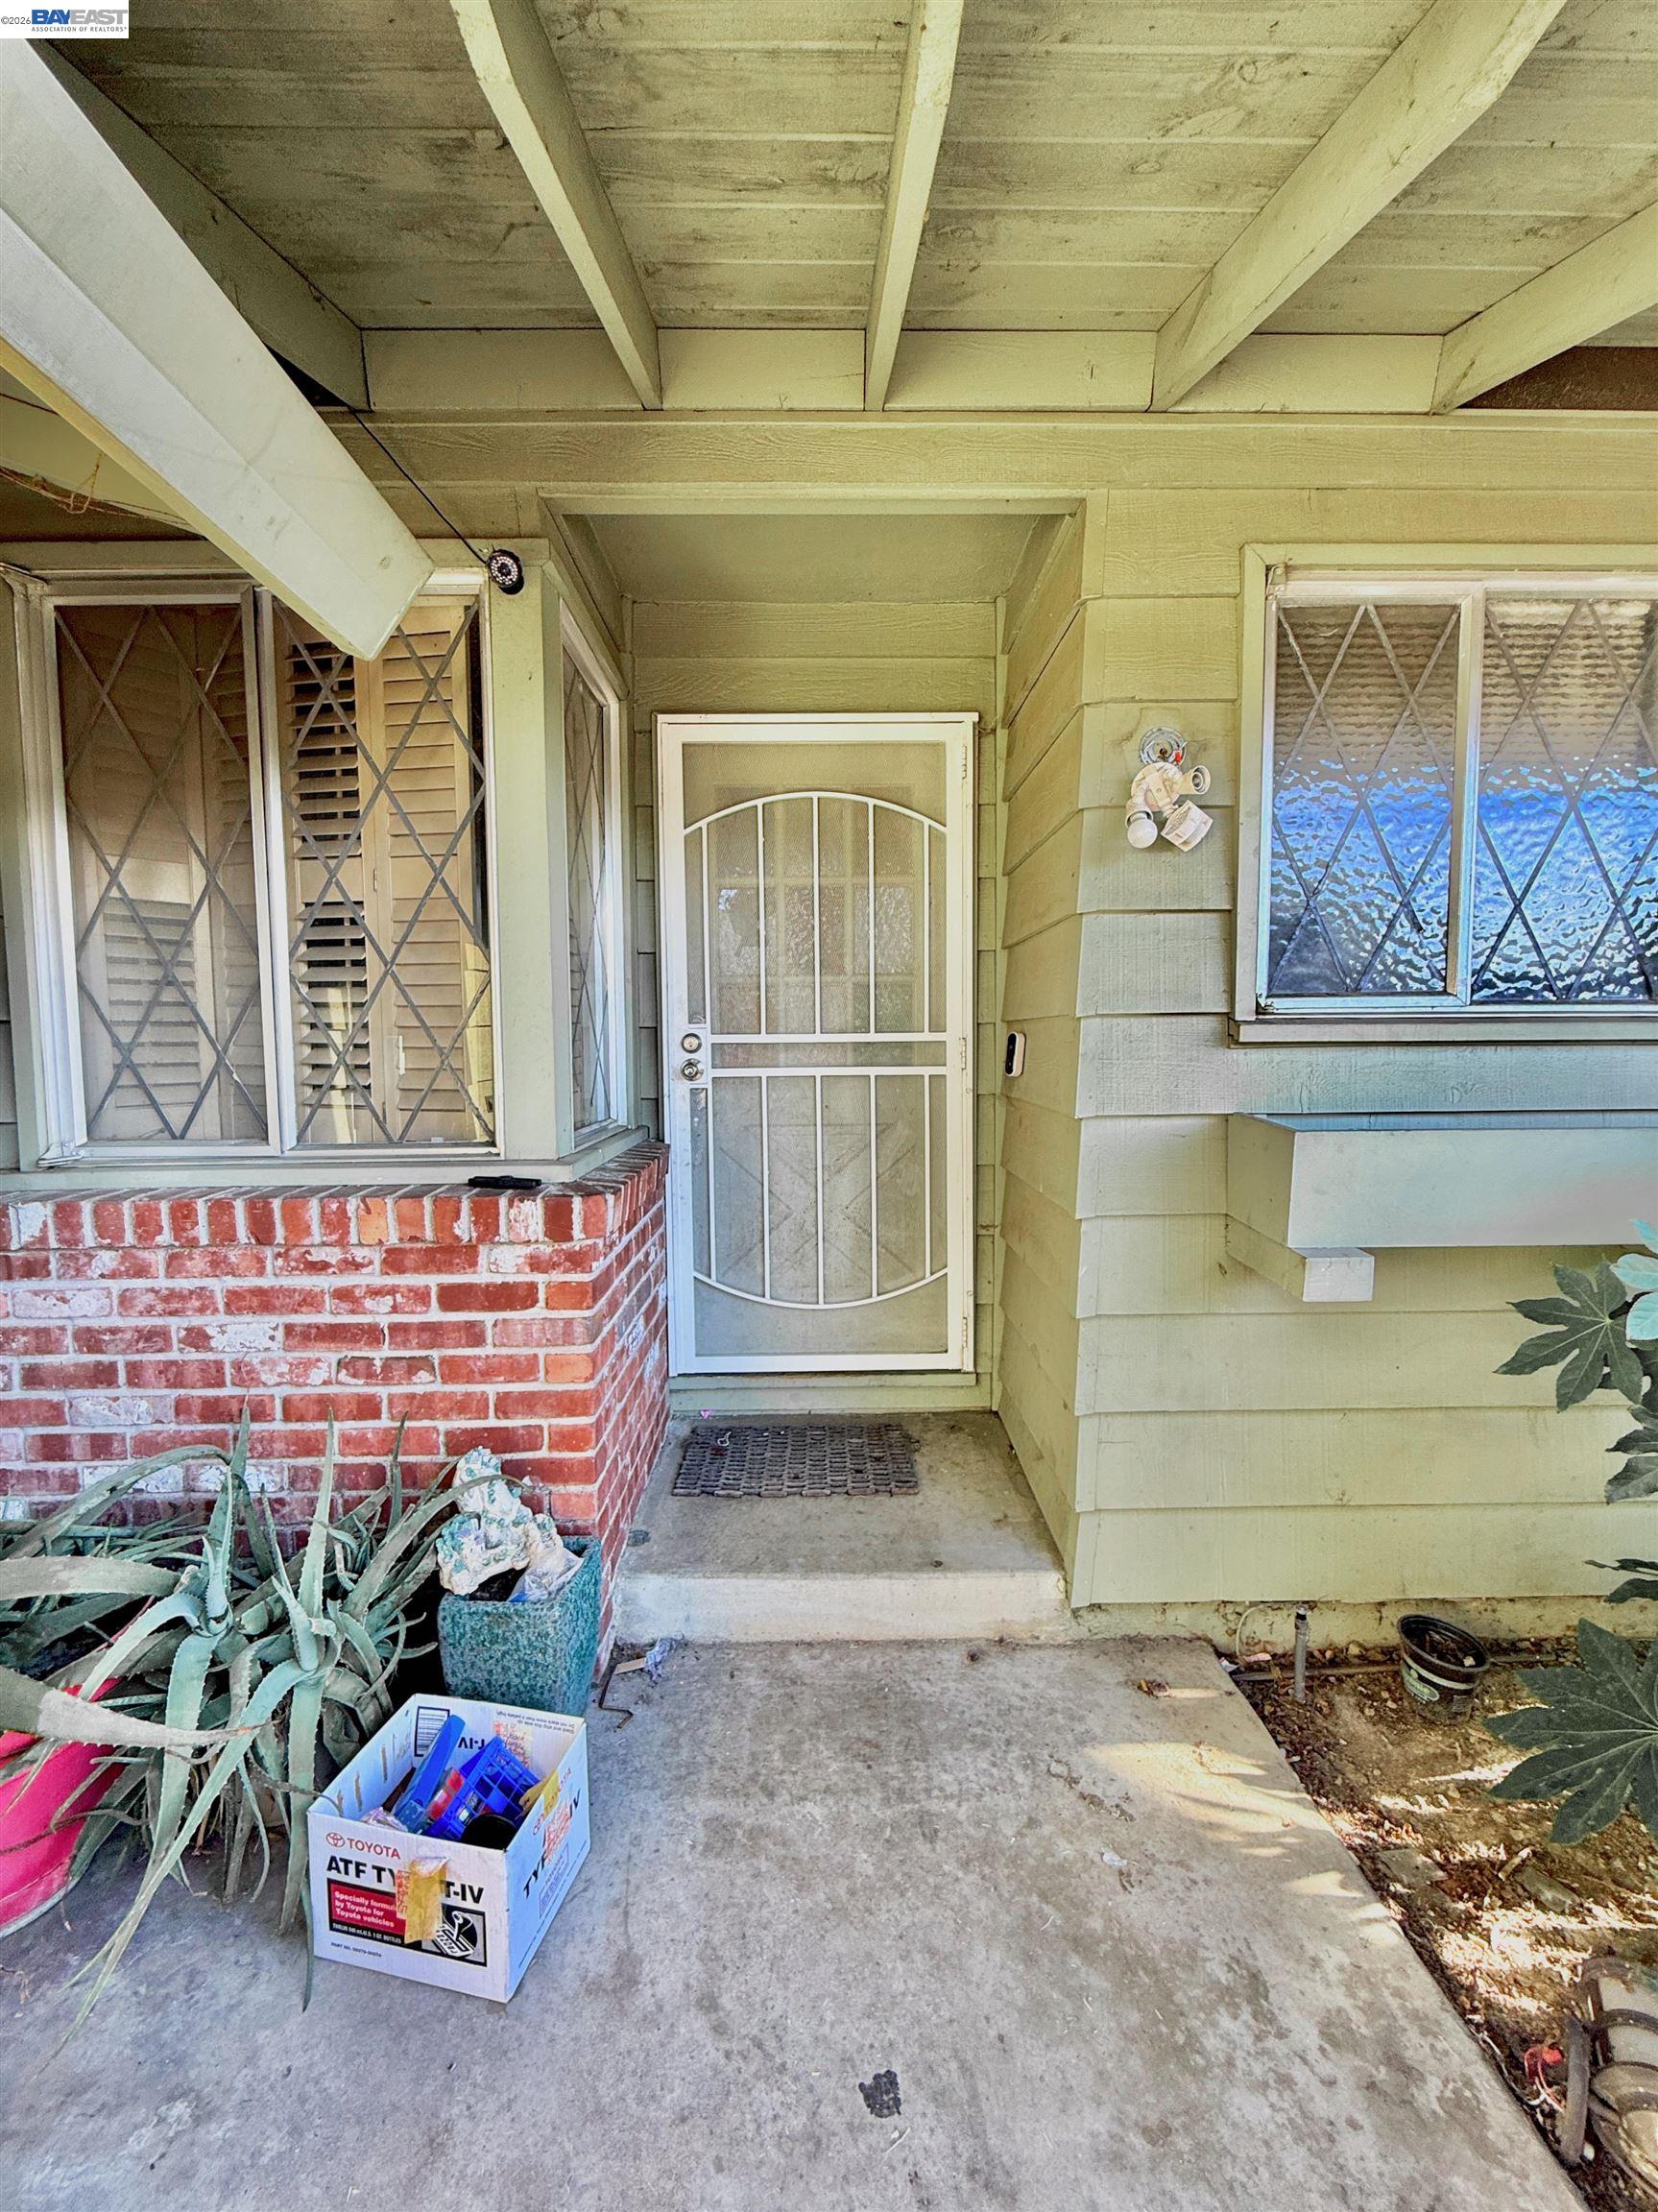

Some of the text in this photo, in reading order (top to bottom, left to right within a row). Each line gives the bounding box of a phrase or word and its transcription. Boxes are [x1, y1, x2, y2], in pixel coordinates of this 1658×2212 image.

[347, 1838, 401, 1860] TOYOTA
[327, 1855, 484, 1904] ATF TY T-IV
[334, 1891, 396, 1911] Specially formul
[335, 1900, 345, 1909] by
[347, 1902, 372, 1913] Toyota
[336, 1908, 395, 1927] Toyota vehicles
